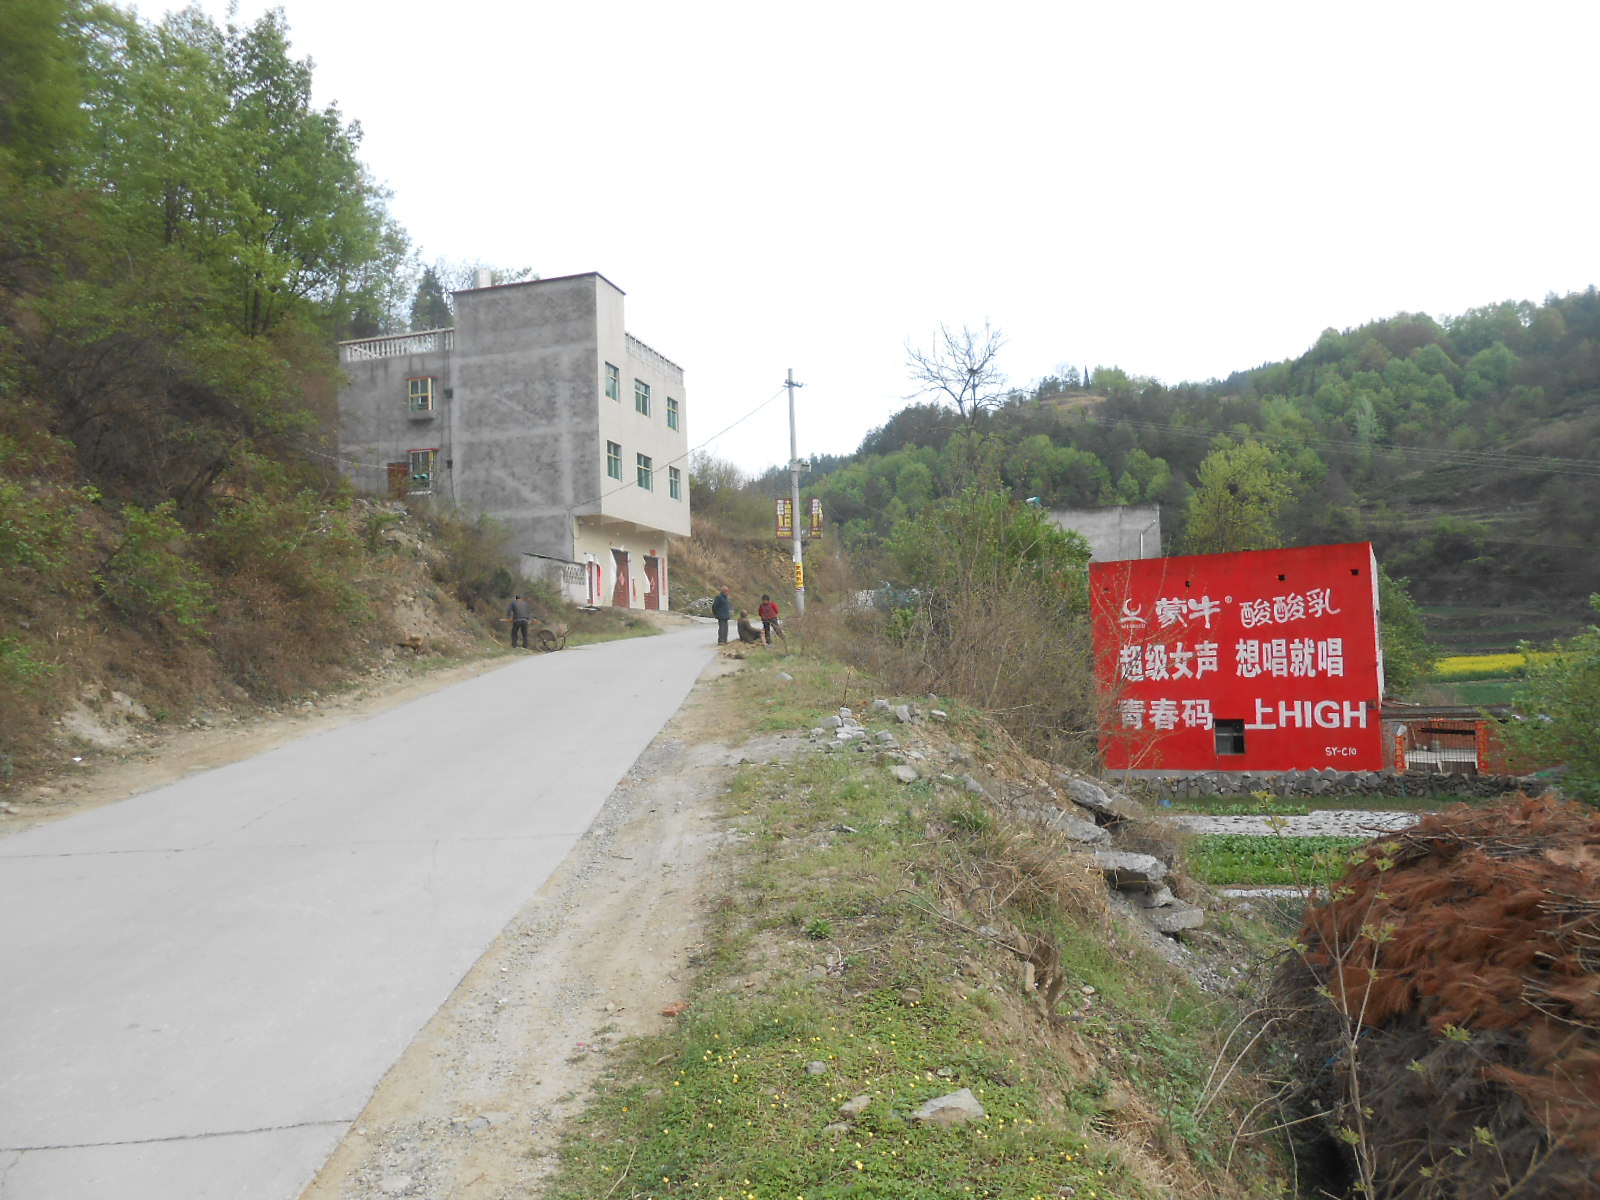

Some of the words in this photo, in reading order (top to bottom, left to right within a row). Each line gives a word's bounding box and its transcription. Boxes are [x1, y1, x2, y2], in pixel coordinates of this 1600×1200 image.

[1155, 595, 1222, 629] 蒙牛
[1240, 588, 1341, 628] 酸酸乳
[1120, 640, 1219, 682] 超级女声
[1235, 638, 1345, 678] 想唱就唱
[1120, 698, 1214, 730] 青春码
[1244, 698, 1367, 730] 上HIGH
